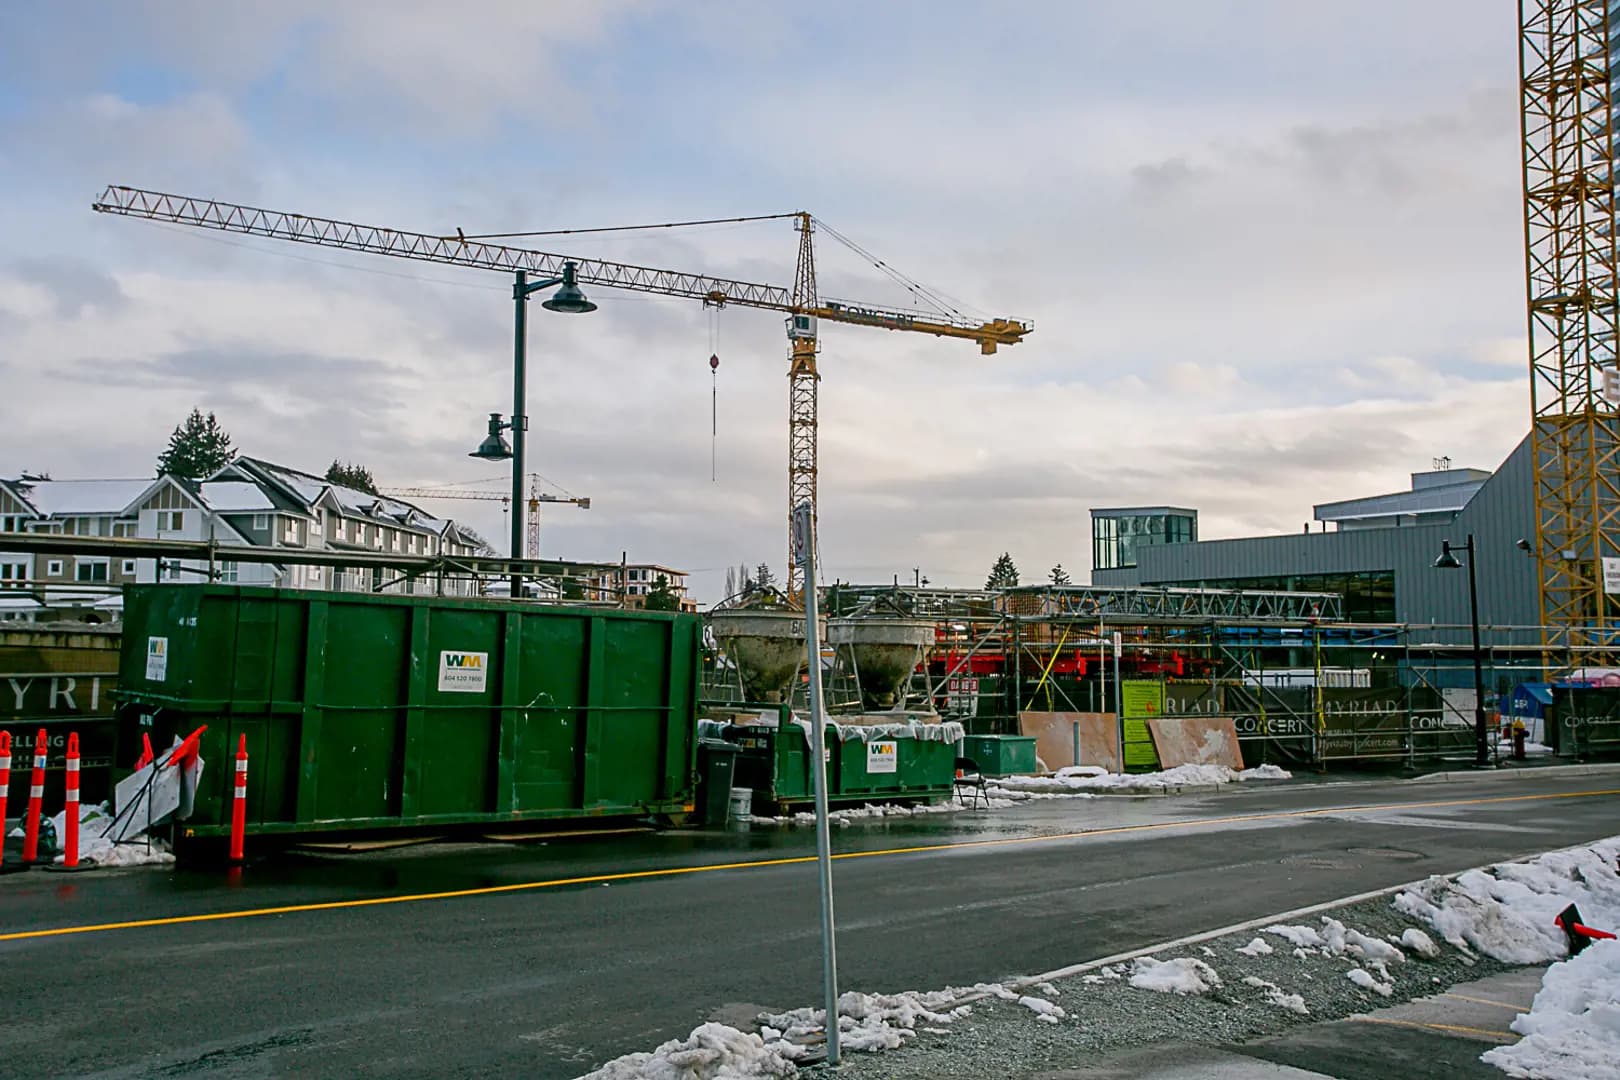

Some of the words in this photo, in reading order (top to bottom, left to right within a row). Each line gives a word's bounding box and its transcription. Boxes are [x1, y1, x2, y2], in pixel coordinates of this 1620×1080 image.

[446, 654, 482, 668] WM
[1233, 717, 1303, 733] COCERT
[871, 744, 893, 755] WM
